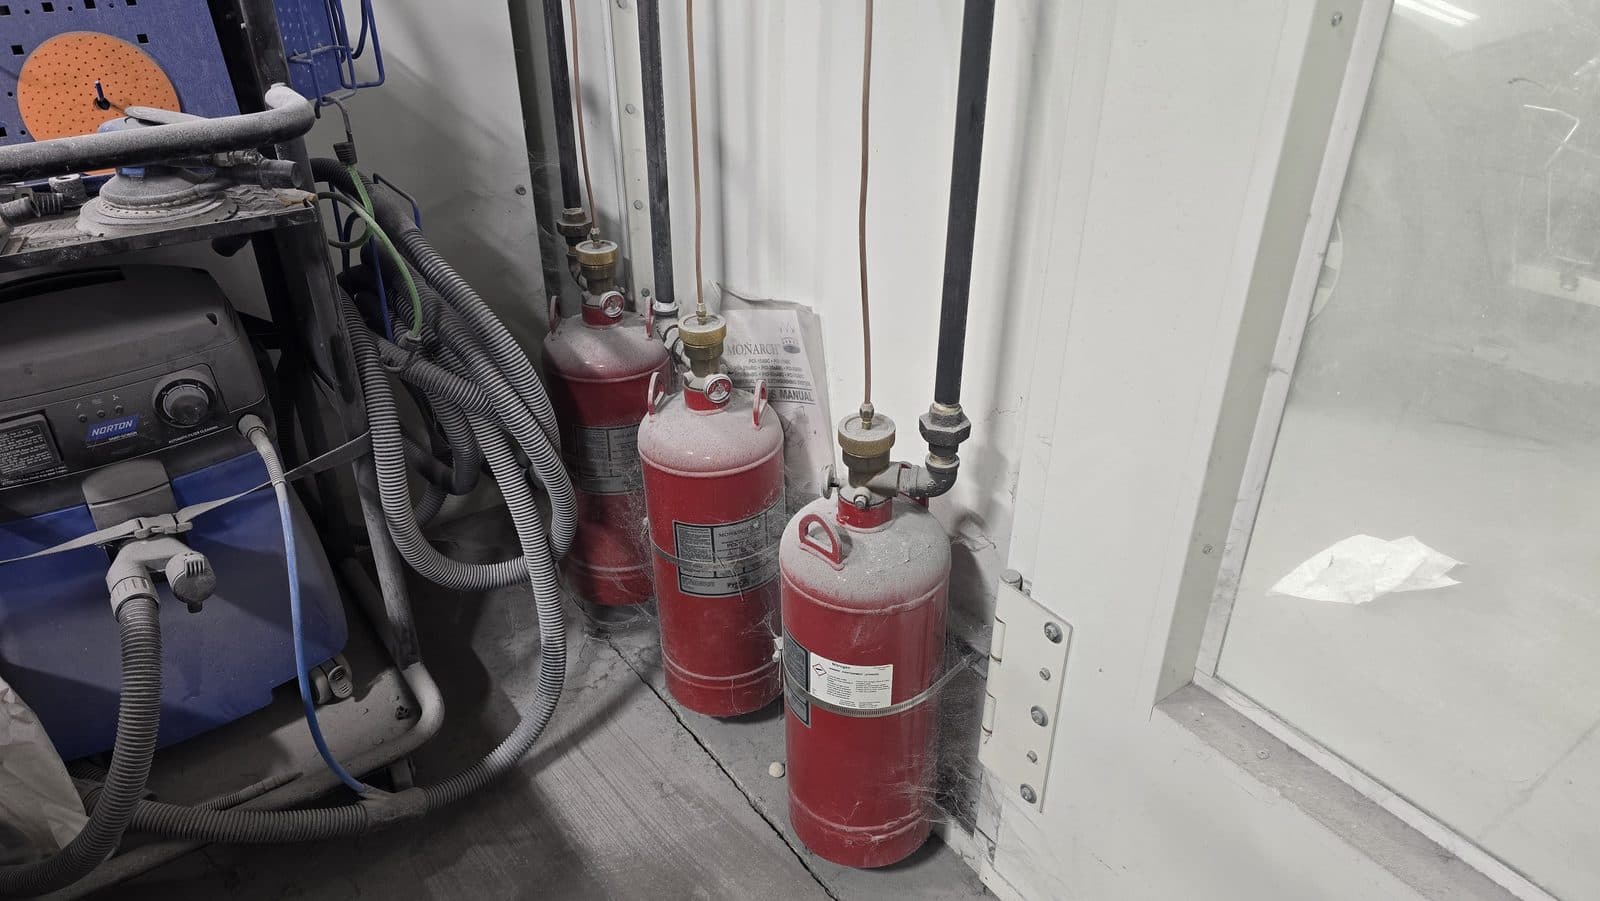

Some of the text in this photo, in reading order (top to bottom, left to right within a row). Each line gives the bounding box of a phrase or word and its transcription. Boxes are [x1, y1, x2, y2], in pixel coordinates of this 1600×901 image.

[727, 342, 778, 356] MONARCH
[781, 389, 813, 401] MANUAL
[91, 420, 133, 437] NORTON
